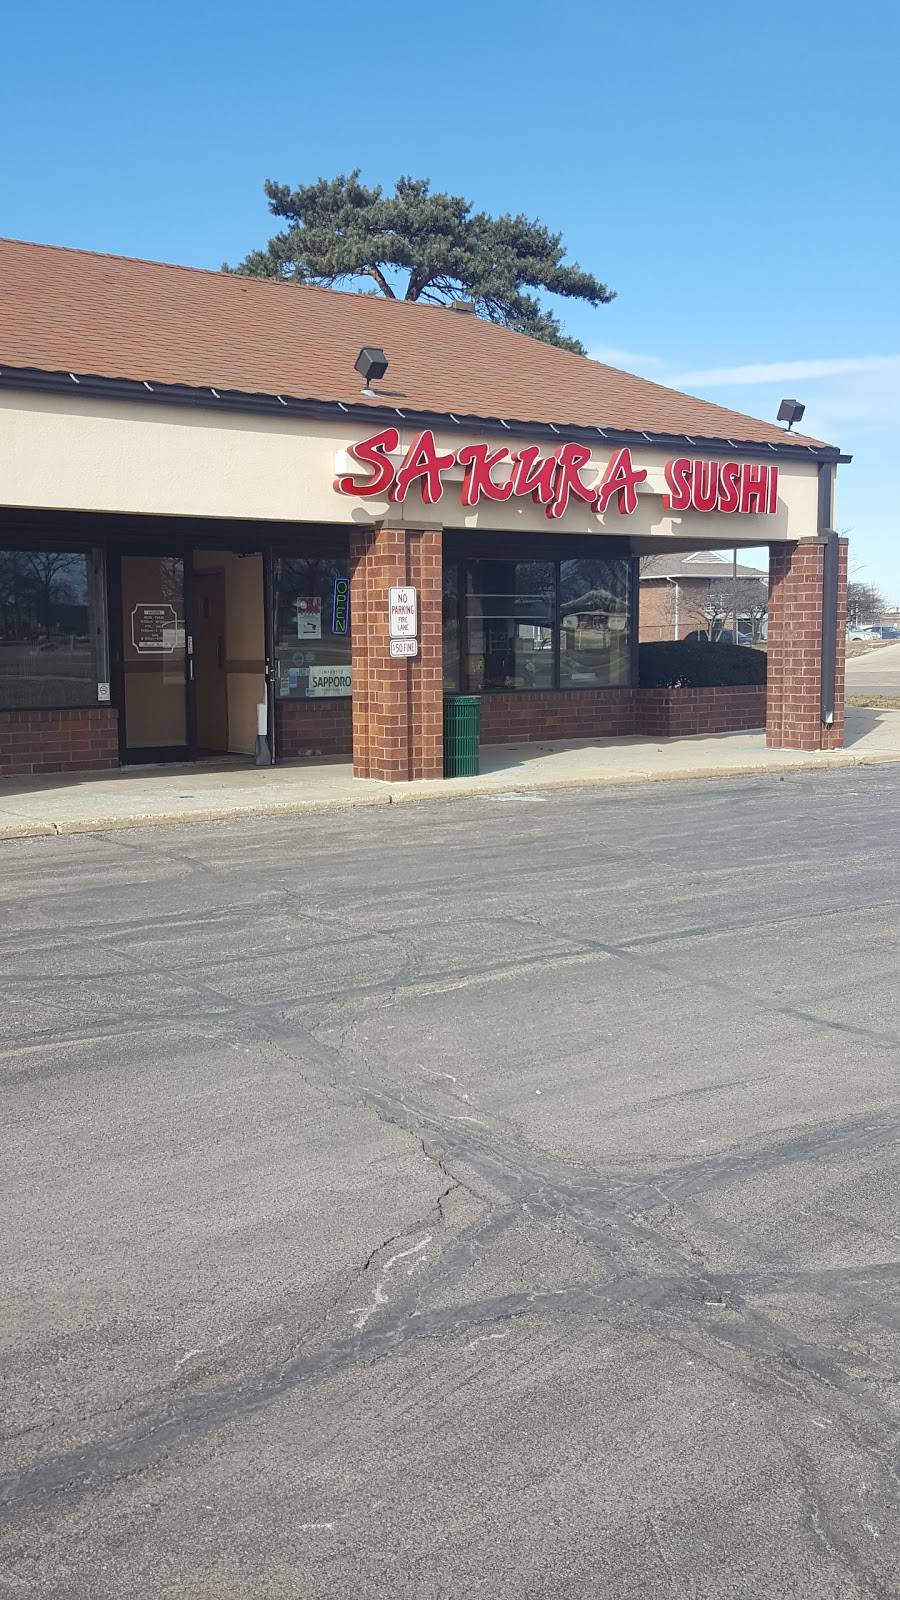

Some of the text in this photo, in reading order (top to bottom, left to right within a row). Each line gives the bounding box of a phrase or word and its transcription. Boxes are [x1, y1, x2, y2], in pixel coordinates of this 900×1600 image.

[334, 427, 779, 519] SAKURA SUSHI
[397, 593, 408, 603] NO
[336, 581, 348, 632] OPEN
[391, 605, 415, 615] PARKING
[398, 616, 408, 624] FIRE
[397, 624, 409, 632] LANE
[392, 642, 415, 653] $50 FINE
[312, 676, 352, 687] SAPPORO
